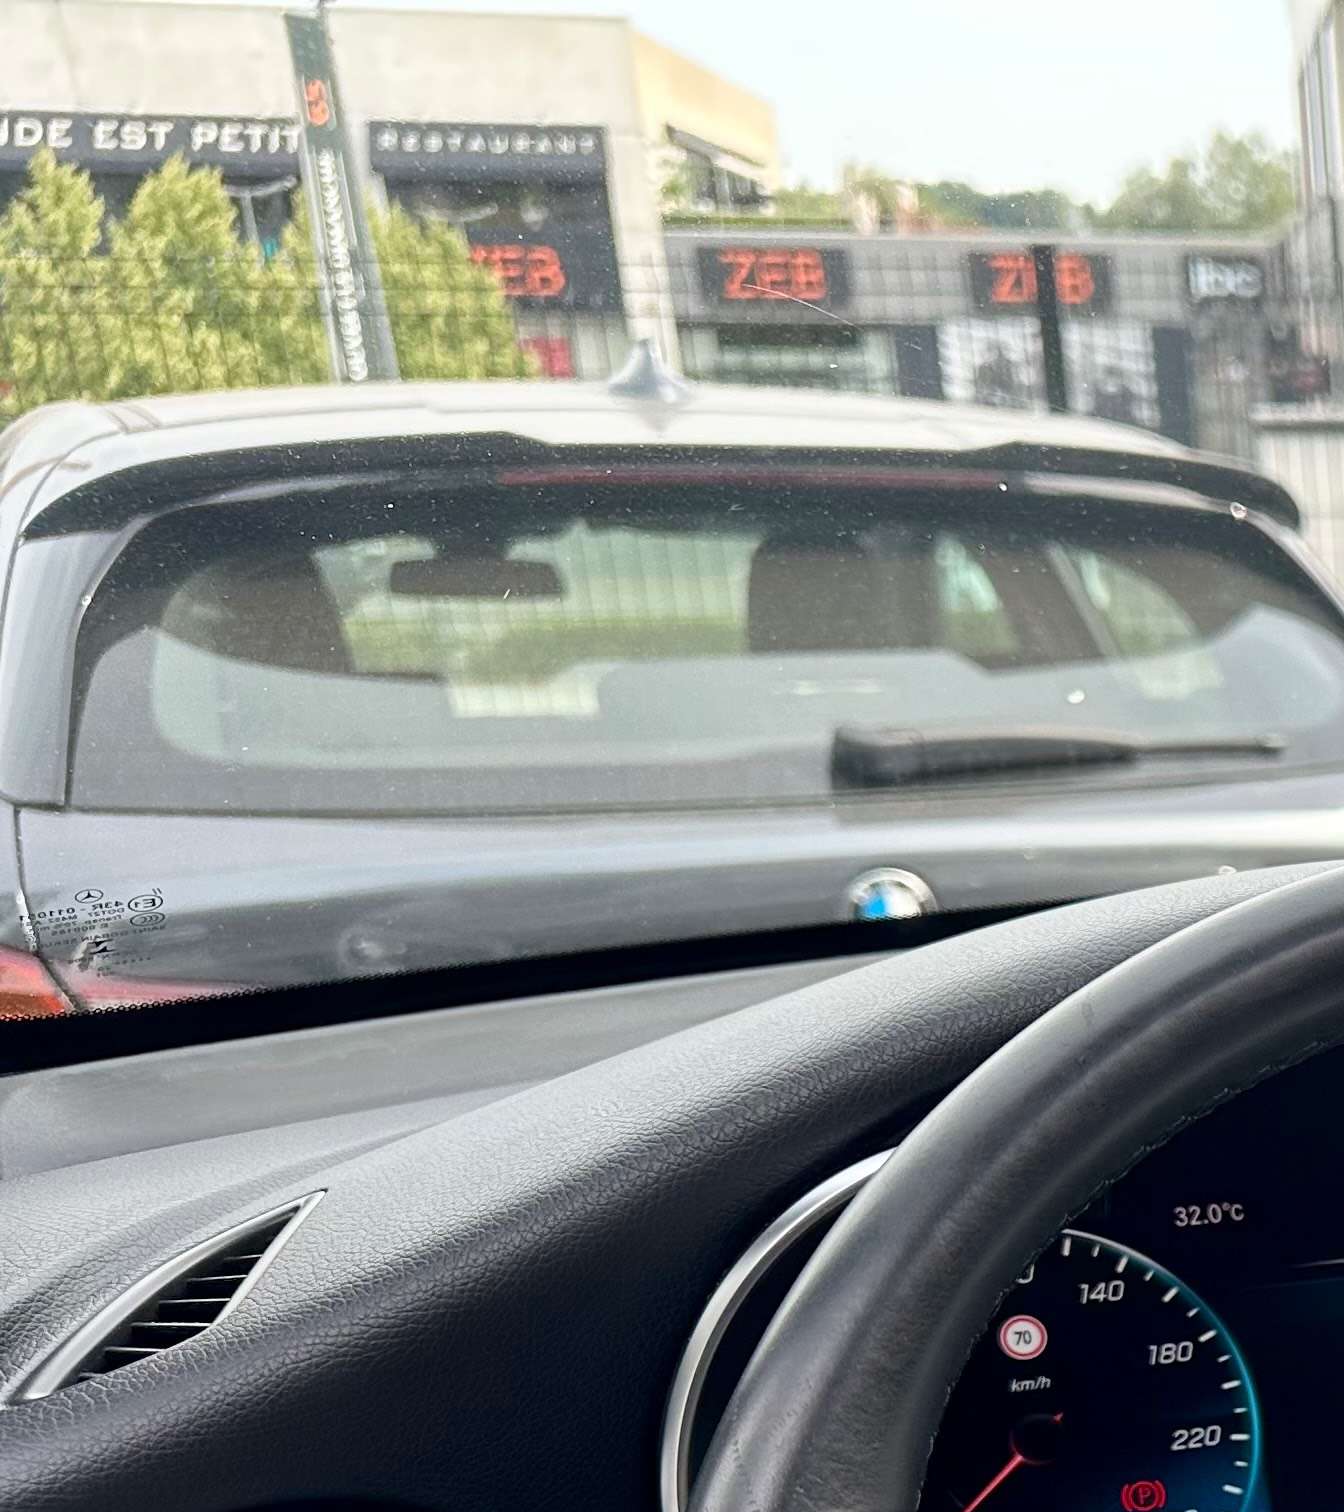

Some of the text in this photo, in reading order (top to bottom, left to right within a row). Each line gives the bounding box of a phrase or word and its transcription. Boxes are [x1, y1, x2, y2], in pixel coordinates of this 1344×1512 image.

[0, 117, 300, 153] DE EST PETIT
[718, 247, 828, 300] ZEB
[1174, 1202, 1245, 1227] 32.0°C
[1079, 1280, 1125, 1305] 140
[1013, 1330, 1033, 1346] 70
[1149, 1341, 1194, 1366] 180
[1009, 1375, 1052, 1393] km/h
[1171, 1425, 1222, 1451] 220
